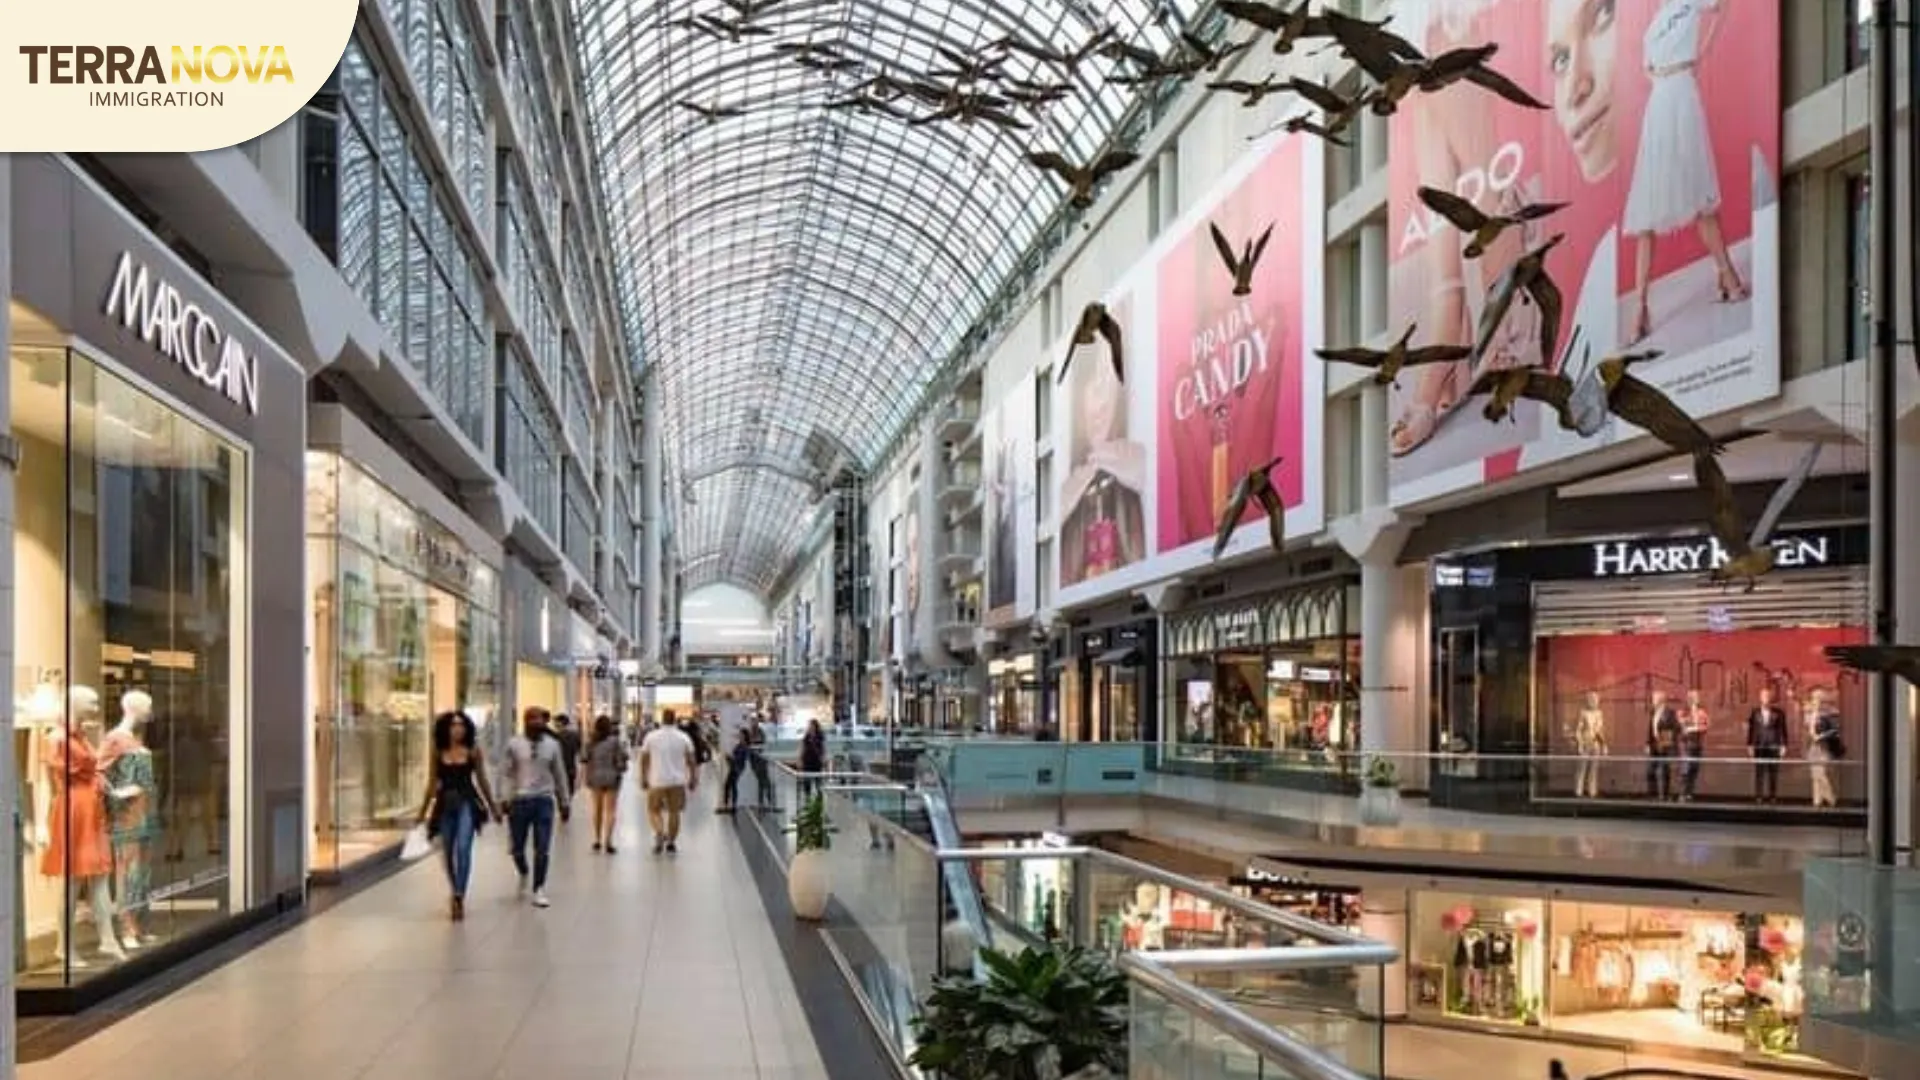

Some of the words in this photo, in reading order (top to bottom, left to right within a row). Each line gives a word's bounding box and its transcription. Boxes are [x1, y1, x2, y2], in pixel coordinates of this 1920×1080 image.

[1191, 302, 1253, 368] PRADA
[1175, 320, 1273, 421] CANDY
[1594, 543, 1705, 576] HARRY
